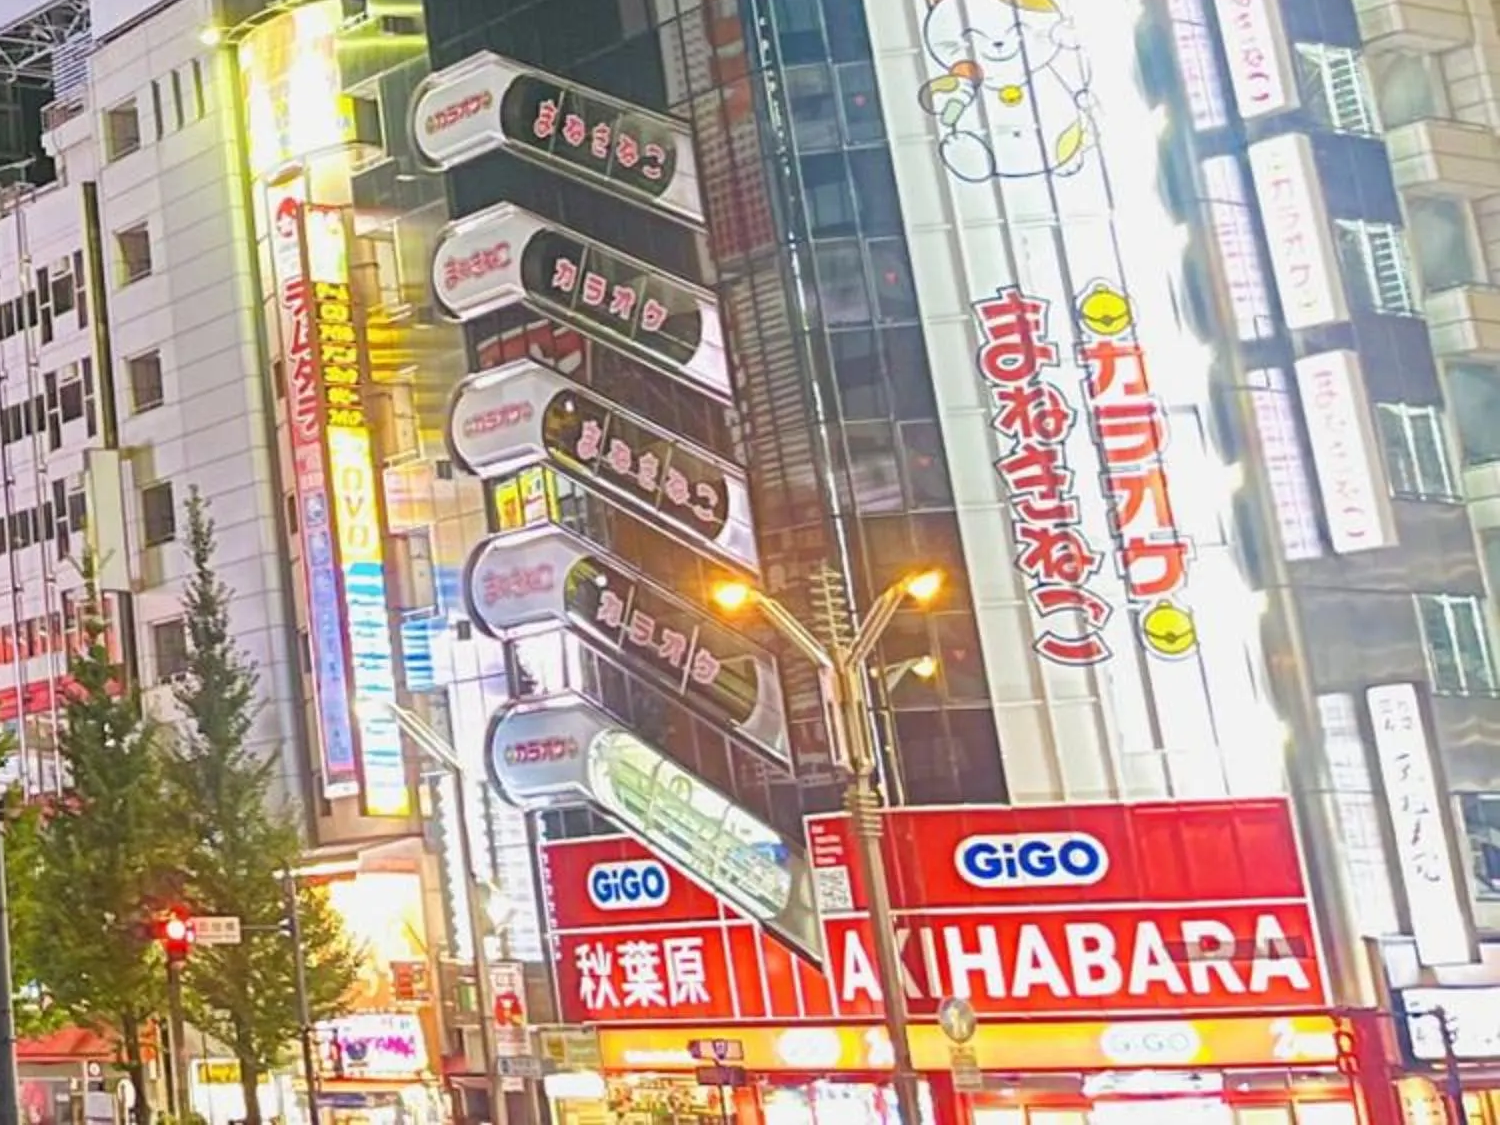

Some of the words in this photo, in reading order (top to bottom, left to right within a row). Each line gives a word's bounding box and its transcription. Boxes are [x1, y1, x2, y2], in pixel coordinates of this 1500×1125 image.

[552, 257, 668, 332] カラオケ
[973, 286, 1114, 667] まねきねこ
[1080, 339, 1192, 599] カラオケ
[596, 589, 721, 686] カラオケ
[592, 865, 666, 904] GiGO
[964, 840, 1100, 879] GiGO
[575, 937, 710, 1011] 秋葉原
[842, 913, 1310, 1002] AKIHABARA
